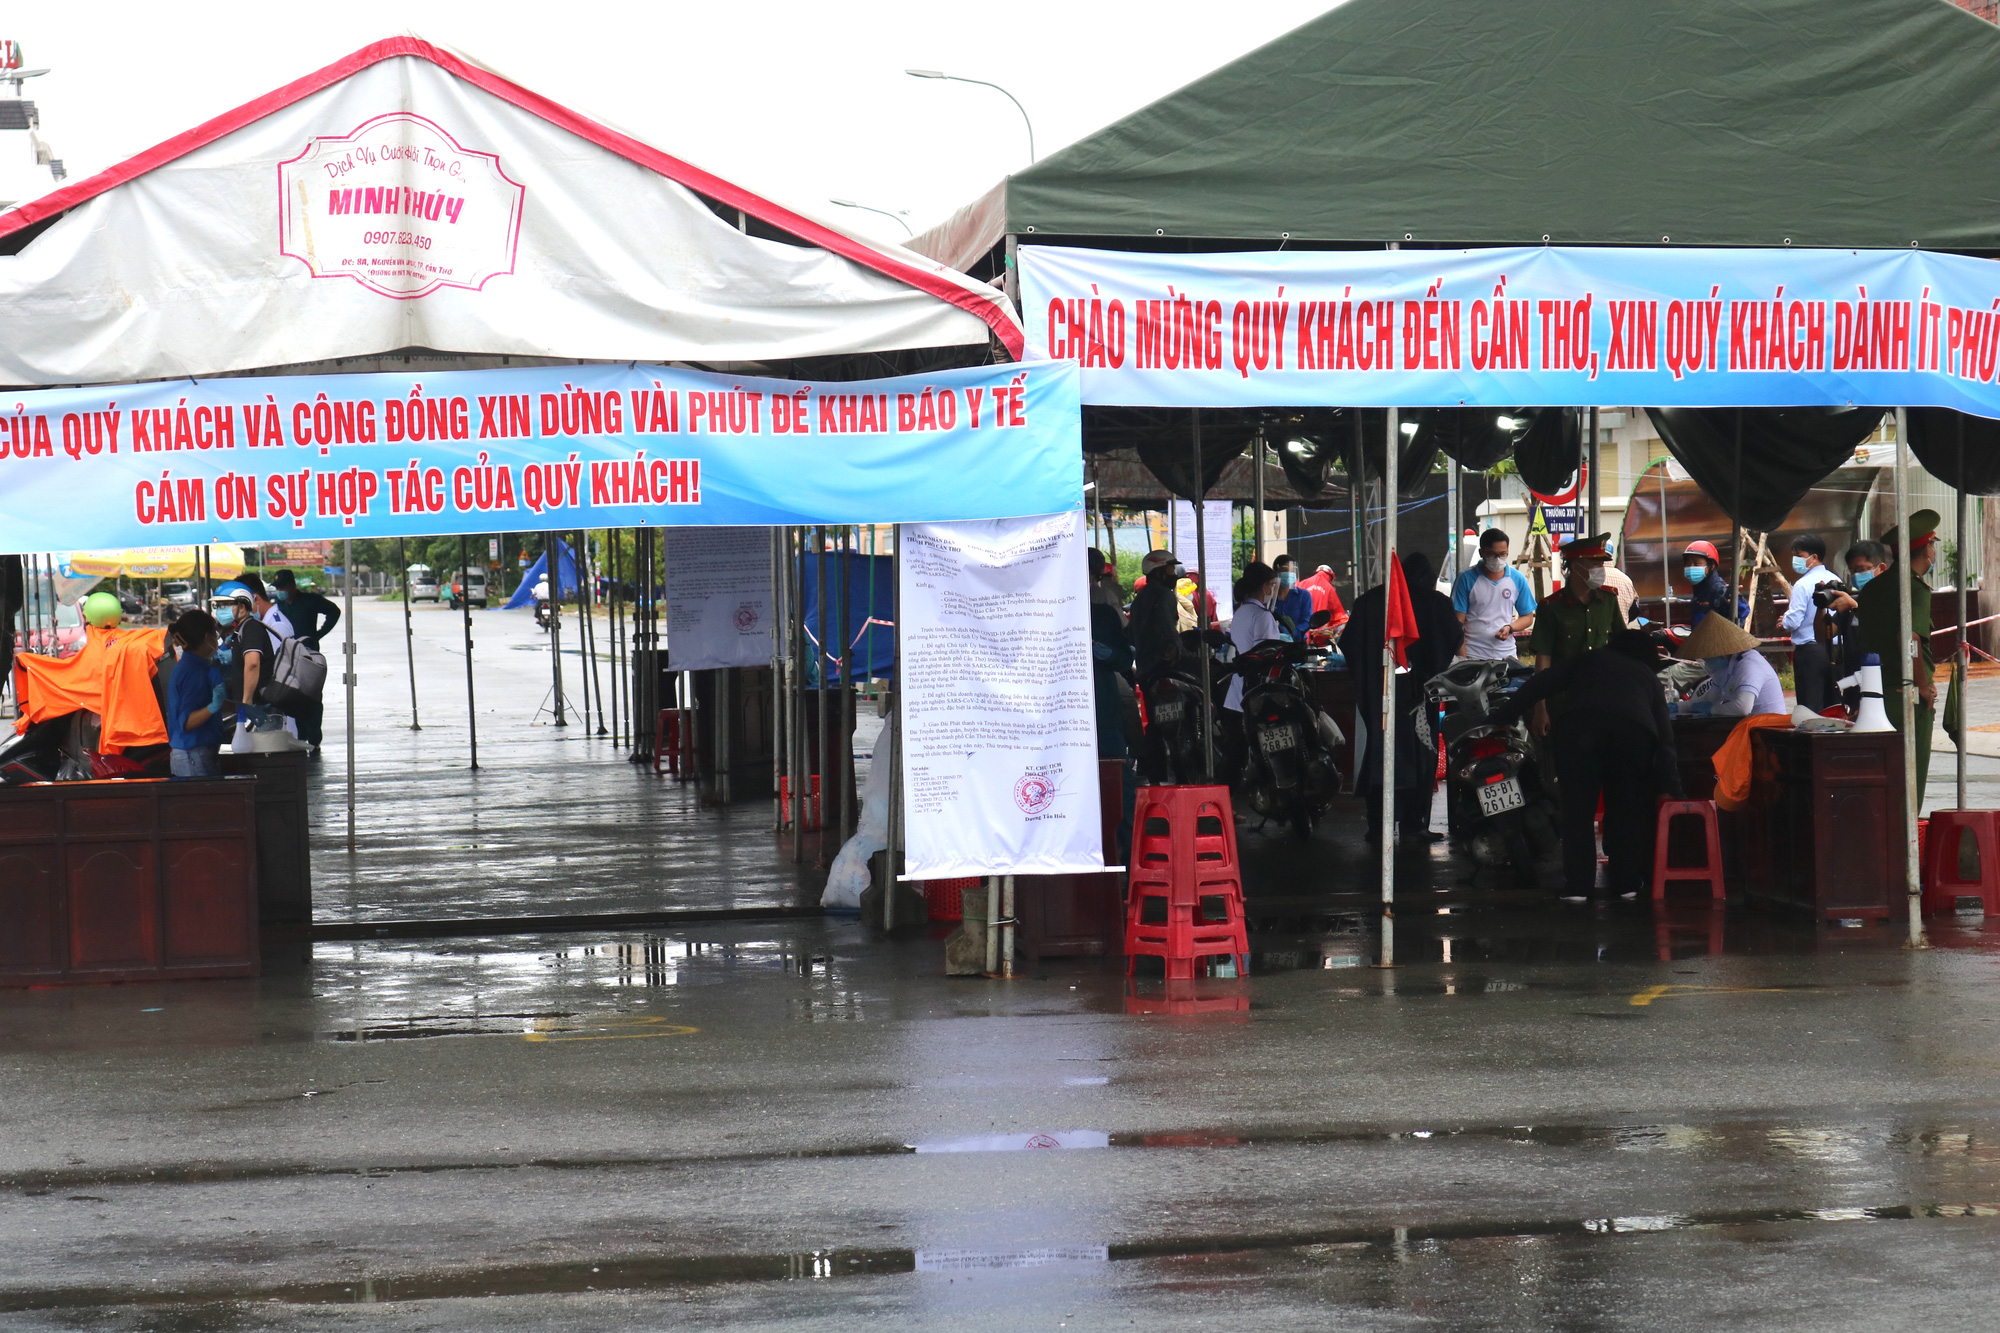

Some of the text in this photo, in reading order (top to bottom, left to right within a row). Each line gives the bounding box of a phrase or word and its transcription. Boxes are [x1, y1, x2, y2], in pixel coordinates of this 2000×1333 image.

[0, 40, 19, 68] L
[324, 153, 355, 178] Dịch
[356, 147, 376, 165] Vụ
[424, 147, 445, 171] Trọn
[329, 186, 464, 224] MINH THÚY
[364, 231, 431, 250] 0907.623.450
[1049, 275, 2000, 383] CHÀO MỪNG QUÝ KHÁCH ĐẾN CẦN THƠ, XIN QUÝ KHÁCH DÀNH ÍT PHÚ
[63, 402, 121, 460] QUÝ
[132, 398, 235, 452] KHÁCH
[244, 395, 283, 447] VÀ
[293, 393, 376, 454] CỘNG
[385, 384, 469, 442] ĐỒNG
[479, 395, 531, 438] XIN
[541, 383, 622, 436] DỪNG
[631, 381, 679, 433] VÀI
[689, 385, 763, 434] PHÚT
[771, 386, 809, 434] ĐỂ
[820, 394, 888, 433] KHAI
[898, 387, 955, 432] BÁO
[967, 388, 983, 428] Y
[992, 373, 1027, 427] TẾ
[136, 451, 699, 526] CÁM ƠN SỰ HỢP TÁC CỦA QUÝ KHÁCH!
[1566, 508, 1583, 517] XUYN
[907, 537, 924, 545] THNH
[1484, 780, 1514, 799] 65-B1
[1484, 792, 1522, 814] 261.43
